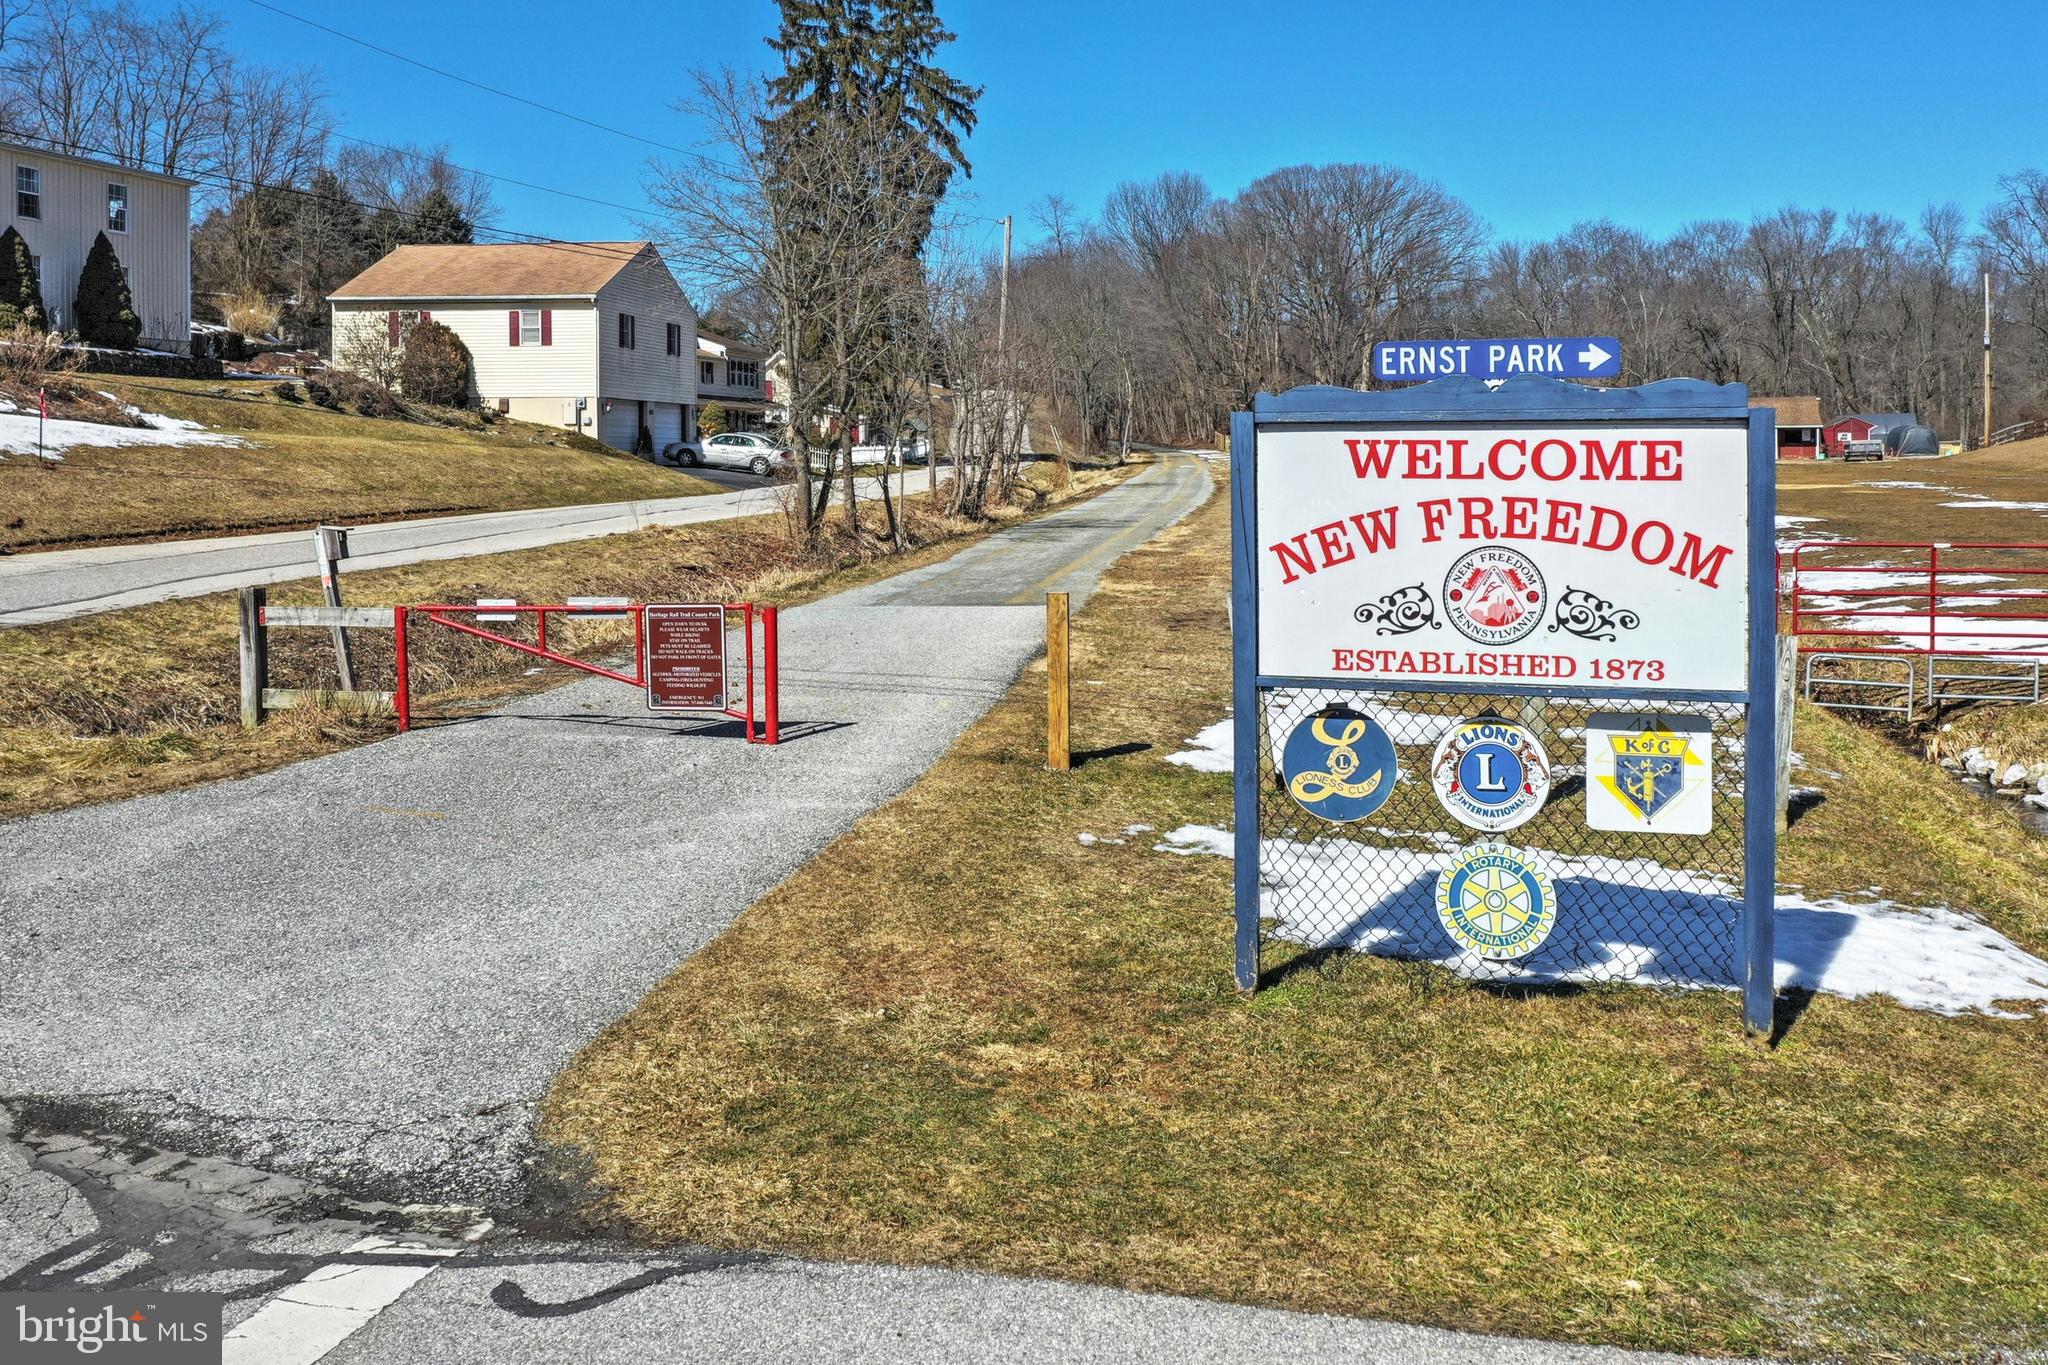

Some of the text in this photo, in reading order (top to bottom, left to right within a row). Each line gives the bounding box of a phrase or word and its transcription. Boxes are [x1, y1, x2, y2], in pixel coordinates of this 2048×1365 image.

[1381, 344, 1564, 375] ERNST PARK
[1344, 438, 1683, 482] WELCOME
[1268, 496, 1733, 589] NEW FREEDOM
[1453, 558, 1475, 584] NEW
[1480, 552, 1537, 586] FREEDOM
[1452, 606, 1537, 639] PENNSYLVANIA
[1331, 648, 1666, 681] ESTABLISHED 1873
[1460, 724, 1520, 747] LIONS
[1625, 738, 1671, 754] K of C
[1339, 755, 1349, 768] L
[1475, 753, 1507, 792] L
[1295, 772, 1377, 795] LIONESS CLUB
[1458, 796, 1526, 818] INTERNATIONAL
[1471, 857, 1520, 872] ROTARY
[1454, 911, 1538, 946] INTERNATIONAL
